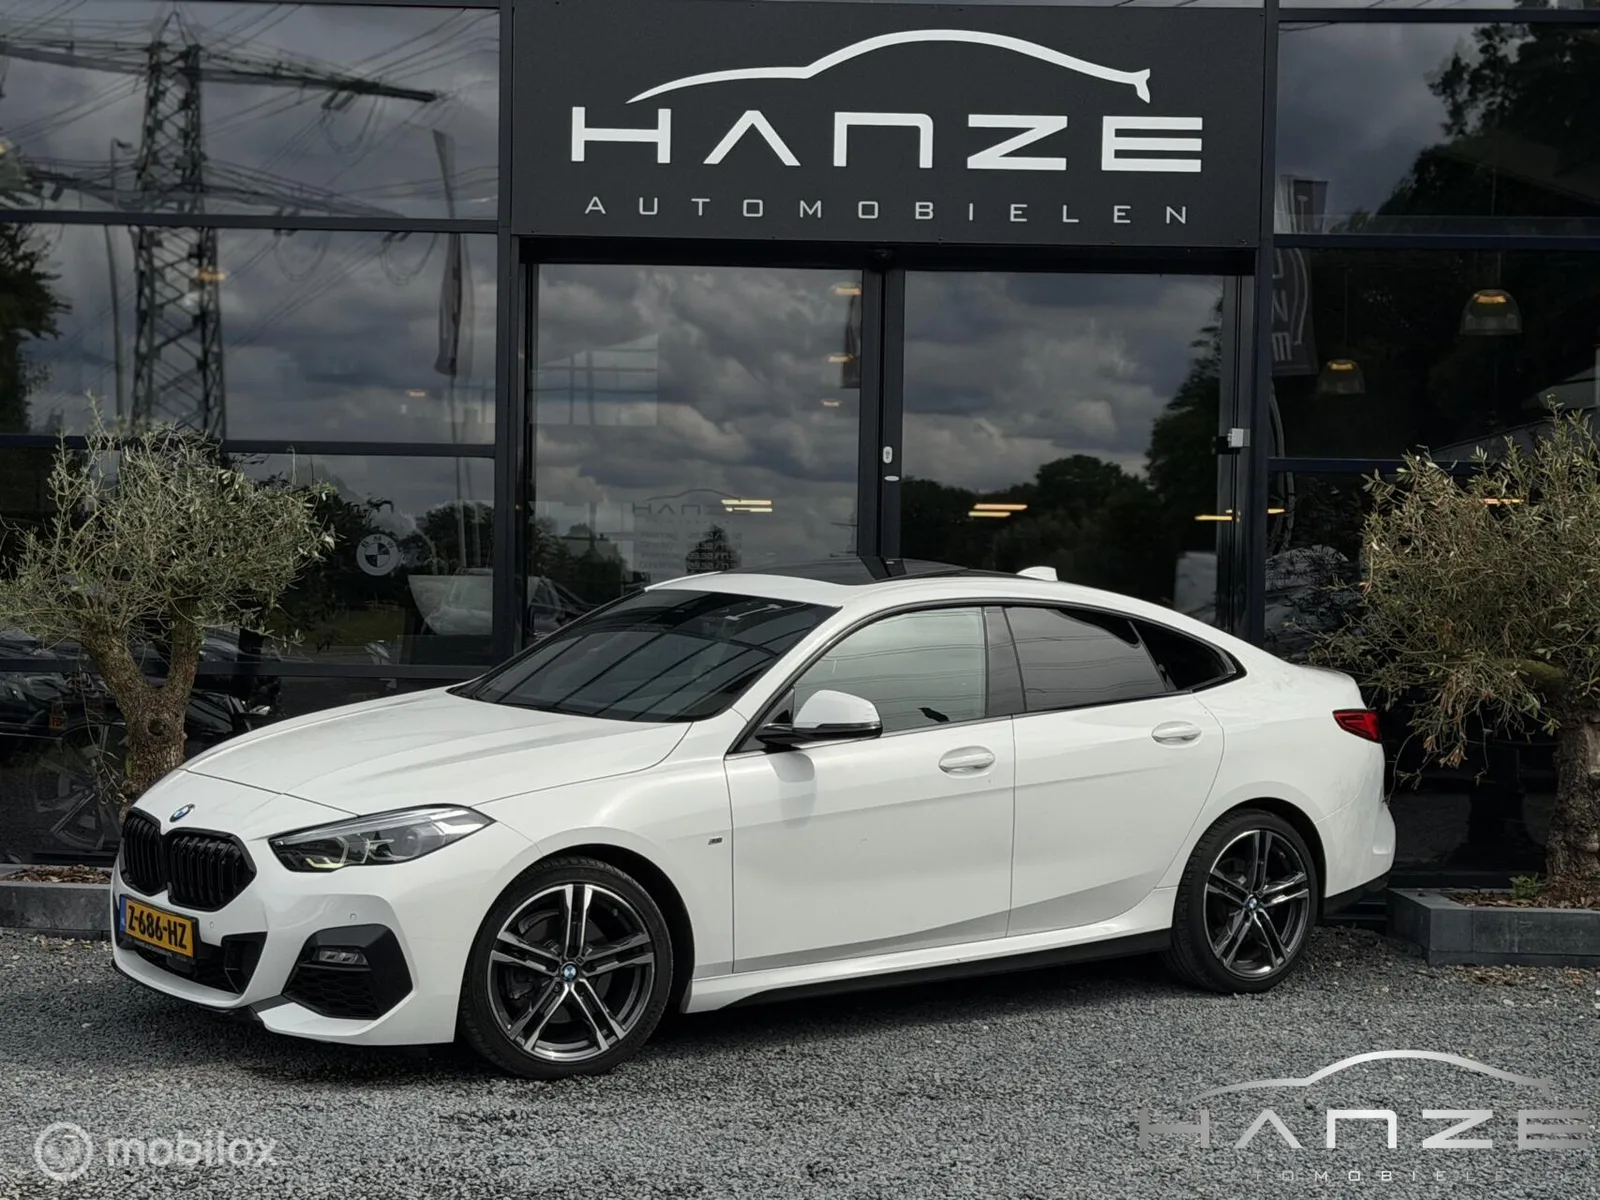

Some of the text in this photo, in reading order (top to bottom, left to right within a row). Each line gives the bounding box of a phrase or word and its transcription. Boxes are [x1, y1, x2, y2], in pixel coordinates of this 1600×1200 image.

[571, 106, 1203, 172] HANZE
[584, 195, 1187, 226] AUTOMOBIELEN
[127, 904, 188, 951] Z-686-HZ
